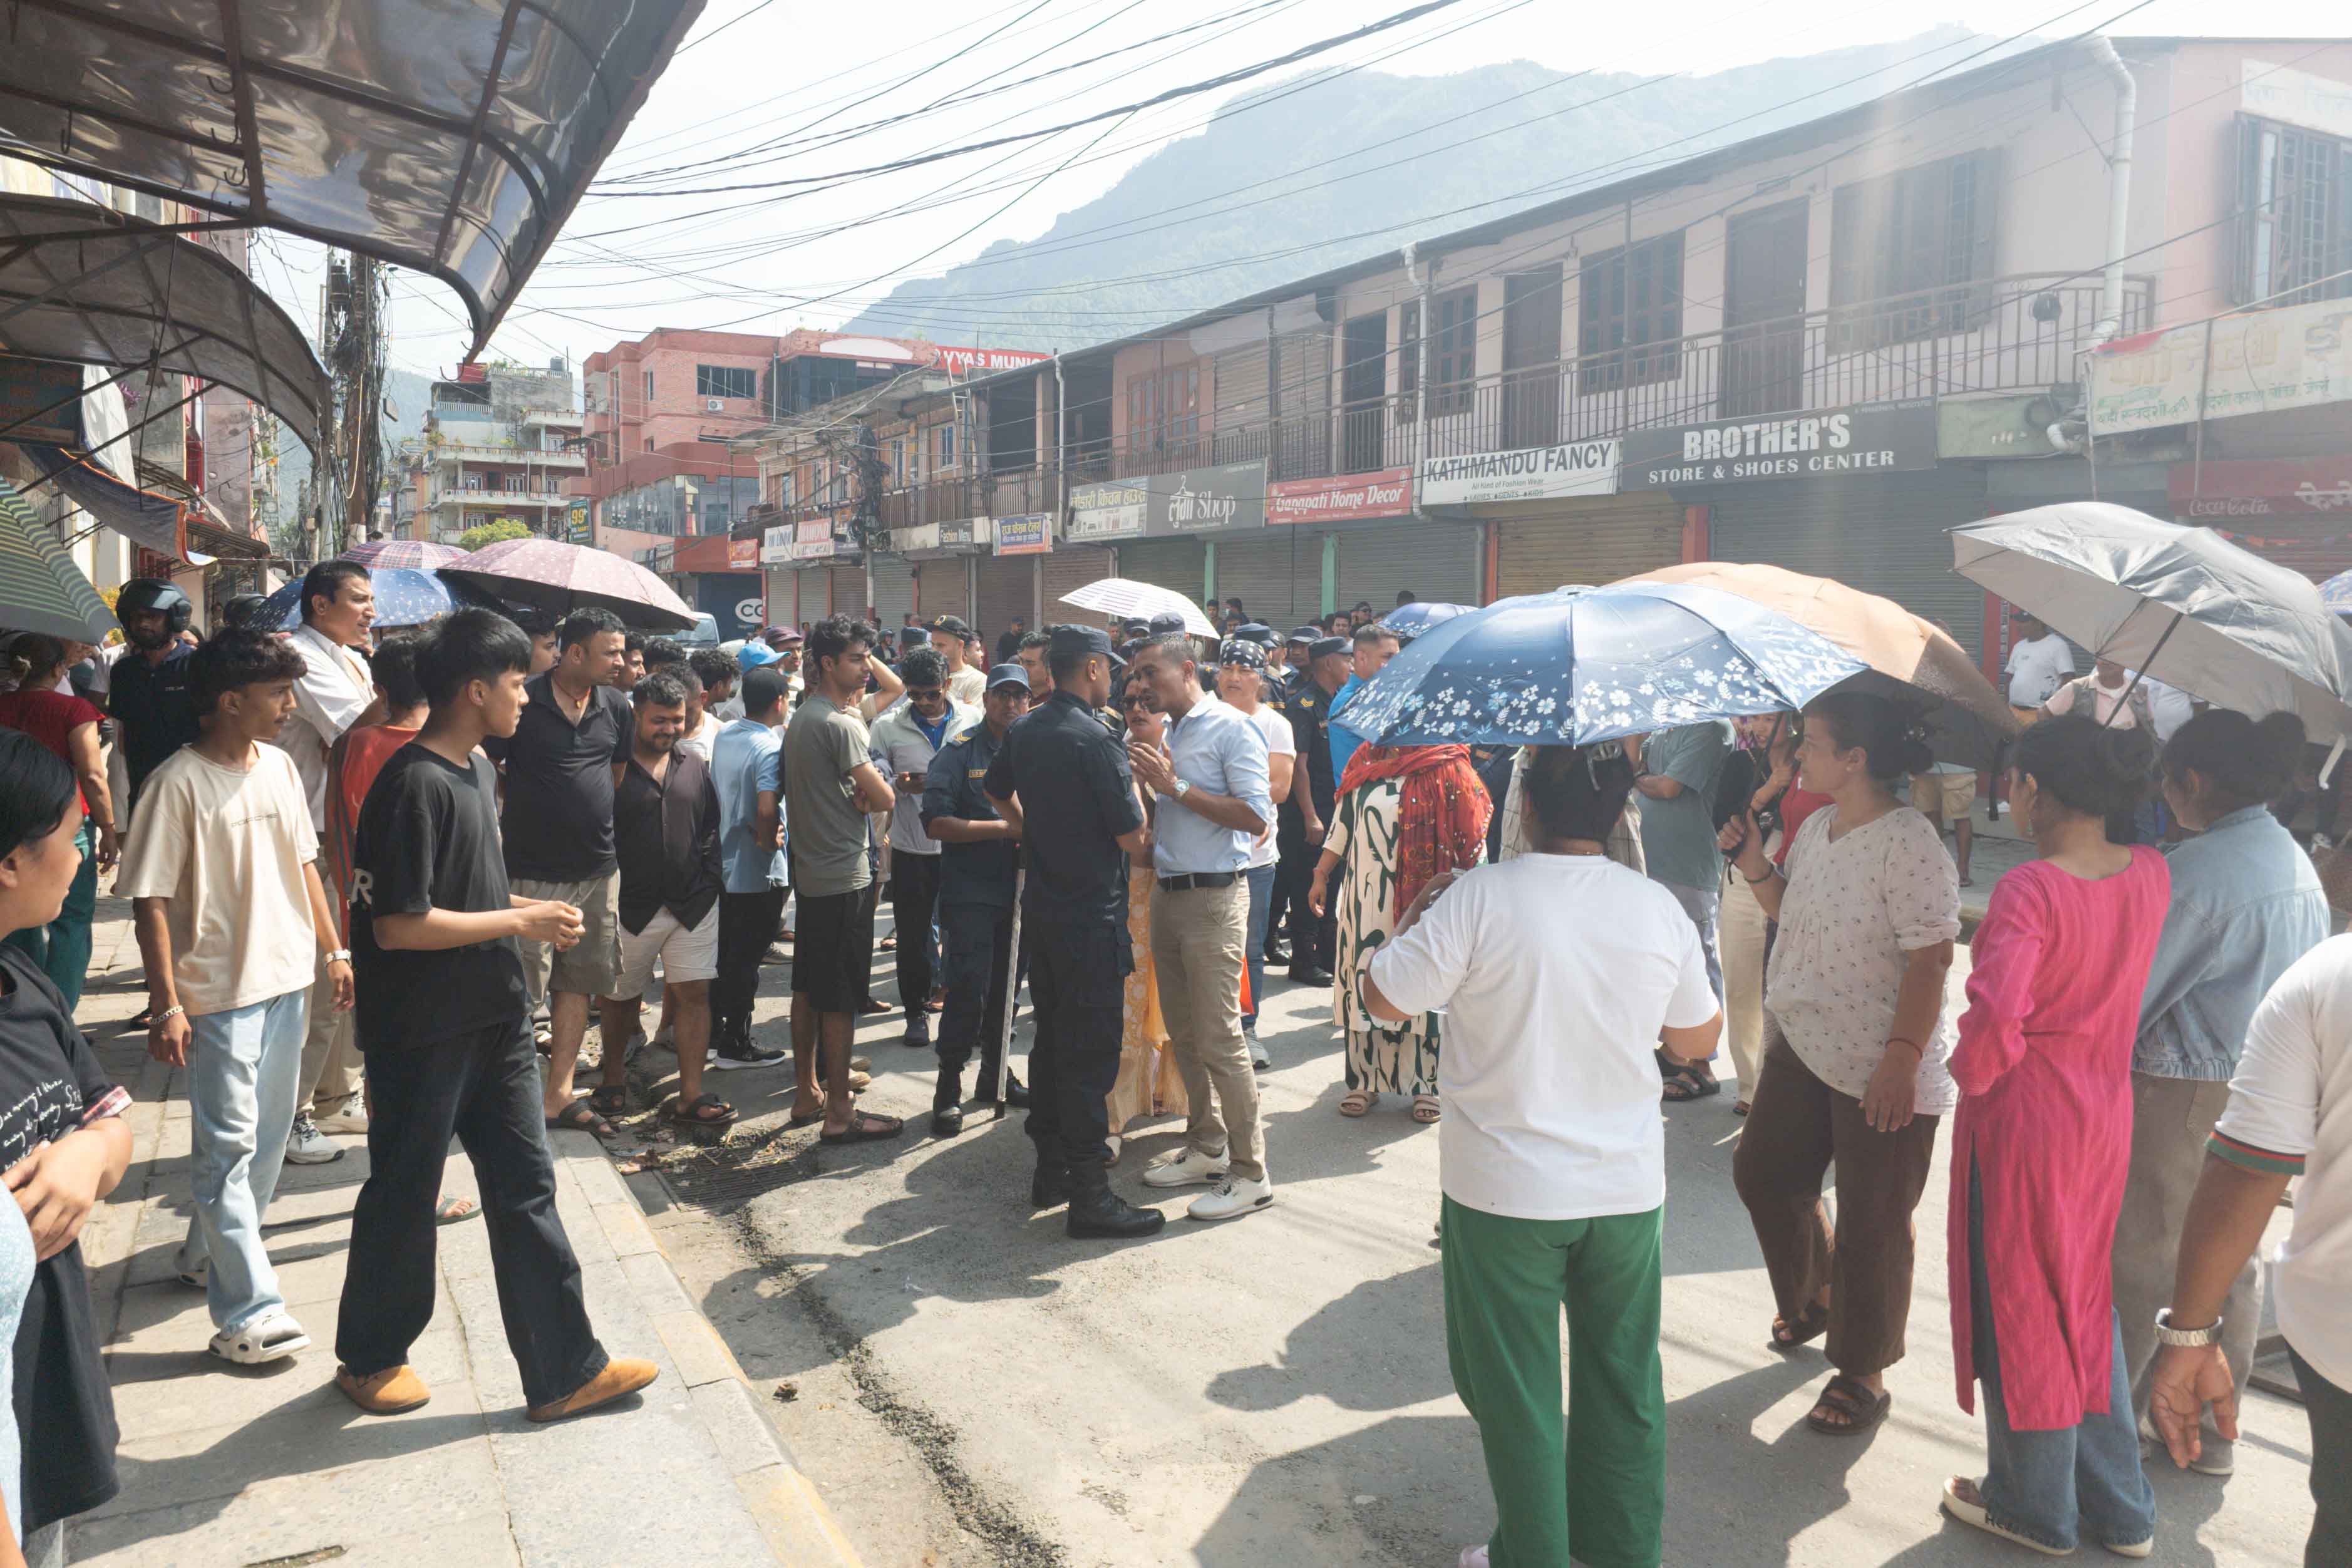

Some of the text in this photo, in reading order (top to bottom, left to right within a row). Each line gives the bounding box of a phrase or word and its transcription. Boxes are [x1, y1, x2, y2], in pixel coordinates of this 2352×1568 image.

[944, 350, 986, 366] VYAS
[1683, 414, 1850, 462] BROTHER'S
[1427, 442, 1612, 482] KATHMANDU FANCY
[1649, 450, 1895, 484] STORE & SHOES CENTER
[1276, 485, 1404, 515] Ganapati Home Decor
[1502, 479, 1527, 488] Fashion
[1527, 478, 1544, 486] Wear
[1197, 490, 1235, 524] Shop
